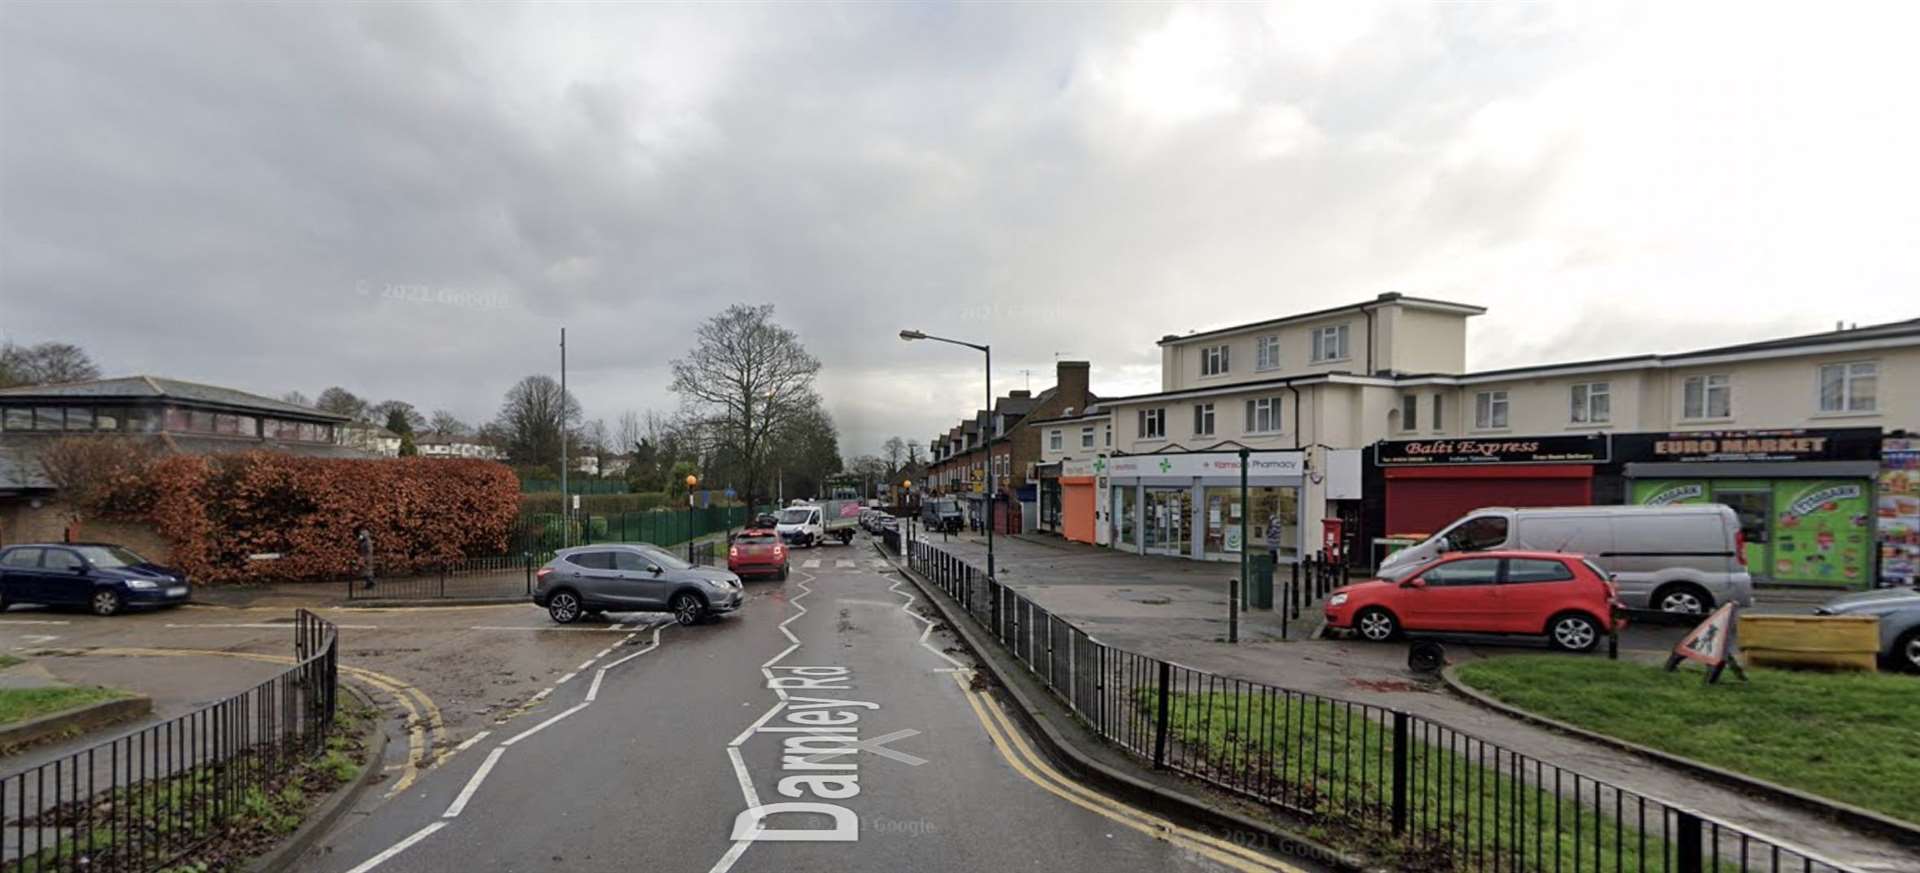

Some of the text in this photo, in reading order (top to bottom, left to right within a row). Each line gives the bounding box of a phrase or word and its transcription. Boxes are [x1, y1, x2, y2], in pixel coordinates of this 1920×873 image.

[1405, 440, 1539, 456] Balti Express
[1656, 437, 1827, 454] EURO MARKET
[1253, 461, 1297, 470] Pharmacy
